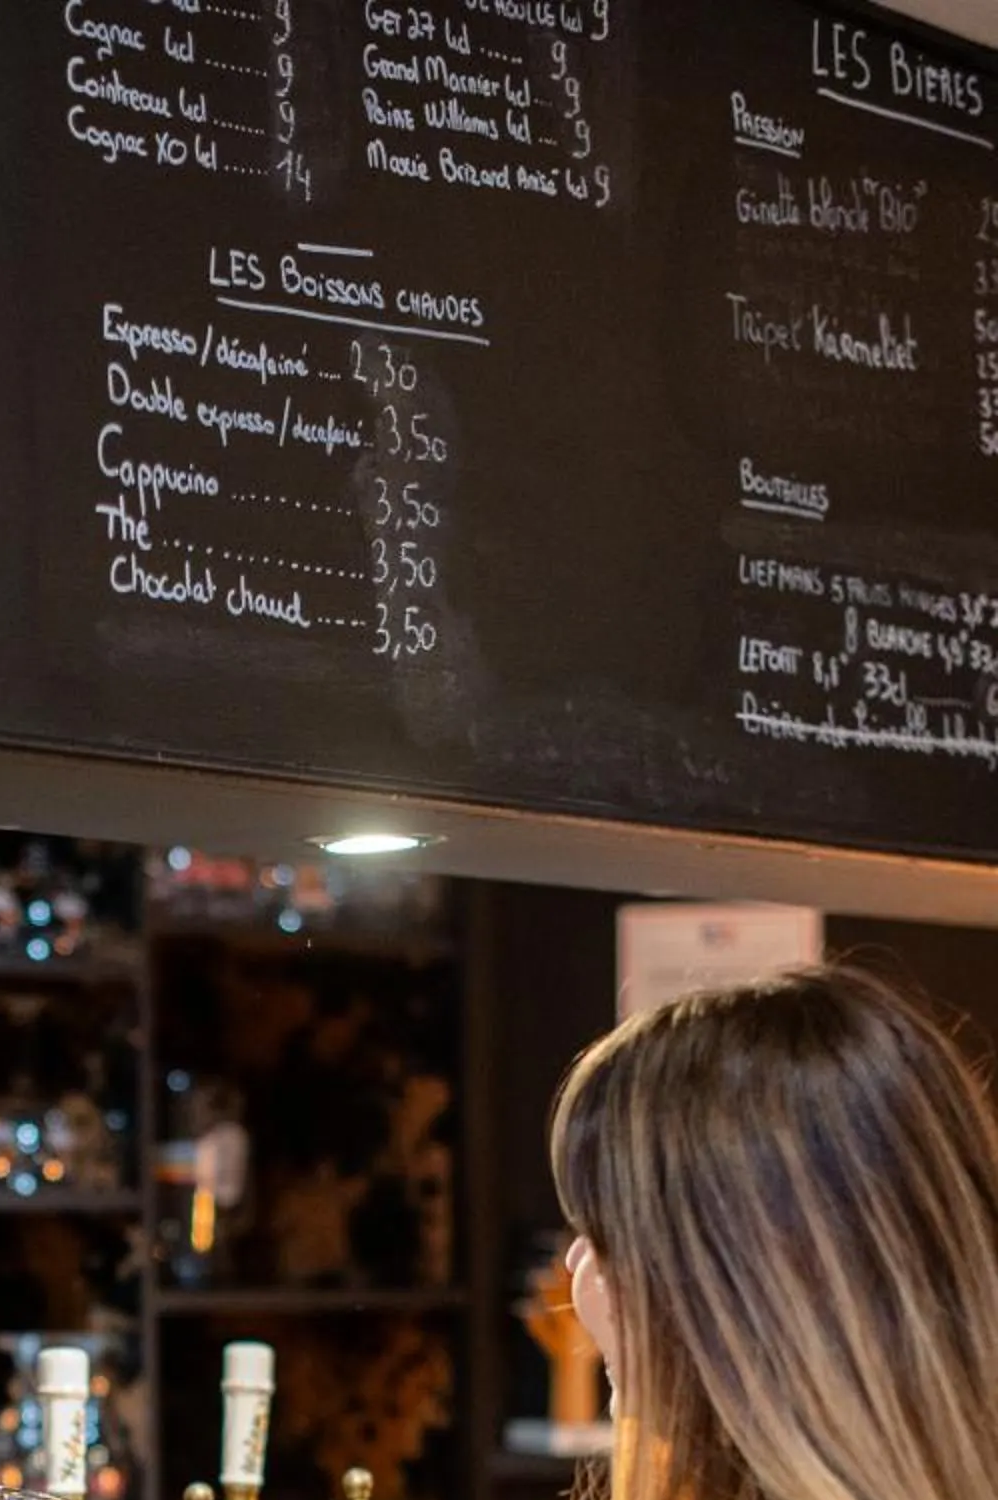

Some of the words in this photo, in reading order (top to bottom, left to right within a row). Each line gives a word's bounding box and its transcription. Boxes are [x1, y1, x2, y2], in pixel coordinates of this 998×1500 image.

[65, 0, 146, 60] Cognac
[406, 8, 436, 41] 27
[812, 18, 871, 90] LES
[66, 56, 173, 118] Cointreau
[363, 43, 418, 85] Grand
[425, 54, 501, 97] Marnier
[424, 97, 499, 140] Williams
[67, 104, 148, 164] Cognac
[155, 131, 188, 165] XO
[276, 149, 312, 203] 14
[439, 147, 510, 191] Brizard
[209, 246, 266, 291] LES
[396, 289, 484, 327] CHAUDES
[352, 340, 418, 397] 2,30
[107, 361, 189, 421] Double
[382, 404, 448, 463] 3,50
[97, 422, 219, 518] Cappucino
[374, 476, 440, 531] 3,50
[371, 537, 437, 595] 3,50
[110, 552, 217, 604] Chocolat
[227, 574, 310, 627] chaud
[372, 602, 437, 661] 3,50
